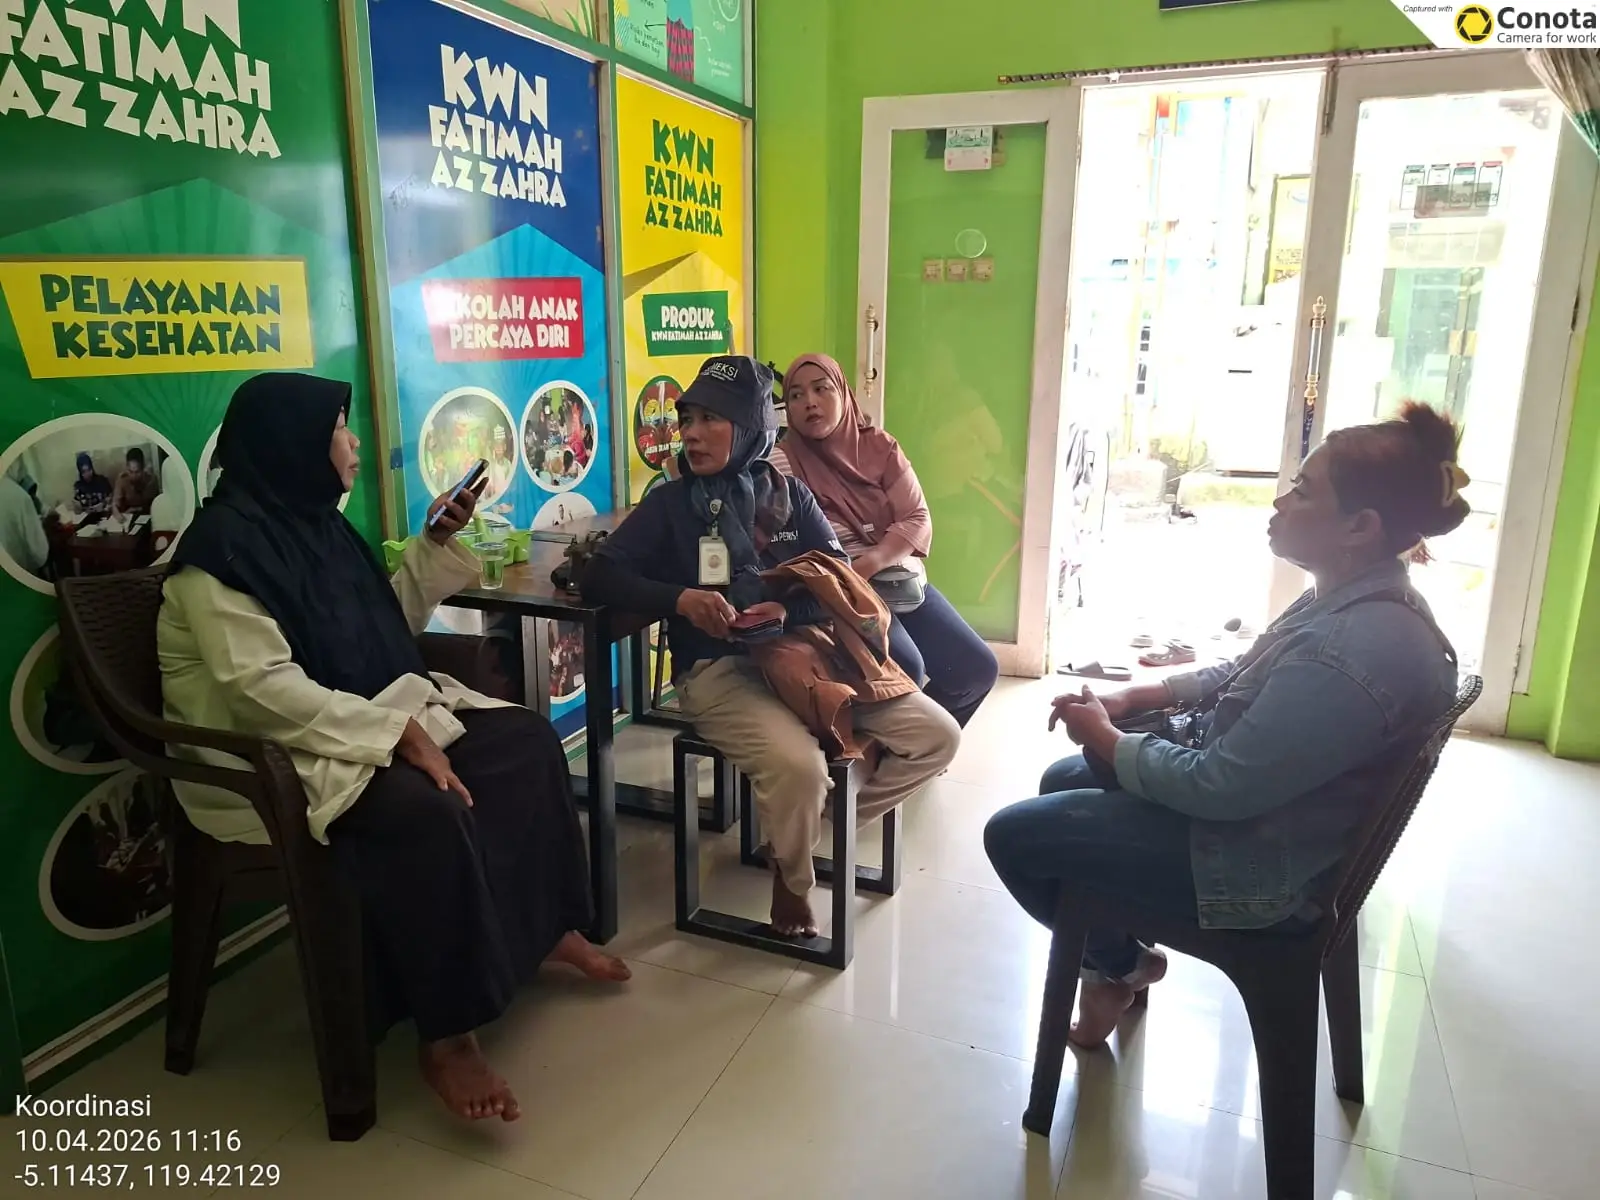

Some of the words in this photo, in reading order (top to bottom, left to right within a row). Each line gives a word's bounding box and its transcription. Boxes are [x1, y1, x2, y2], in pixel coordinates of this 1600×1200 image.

[0, 0, 272, 112] FATIMAH
[0, 59, 87, 128] AZ
[99, 81, 282, 159] ZAHRA
[440, 43, 549, 131] KWN
[428, 104, 563, 174] FATIMAH
[652, 118, 715, 179] KWN
[431, 150, 474, 193] AZ
[479, 160, 567, 208] ZAHRA
[644, 164, 722, 211] FATIMAH
[645, 198, 669, 229] AZ
[672, 204, 723, 238] ZAHRA
[39, 273, 281, 316] PELAYANAN
[434, 293, 525, 321] KOLAH
[528, 295, 579, 321] ANAK
[660, 305, 715, 329] PRODUK
[52, 321, 281, 360] KESEHATAN
[449, 322, 534, 349] PERCAYA
[536, 323, 570, 348] DIRI
